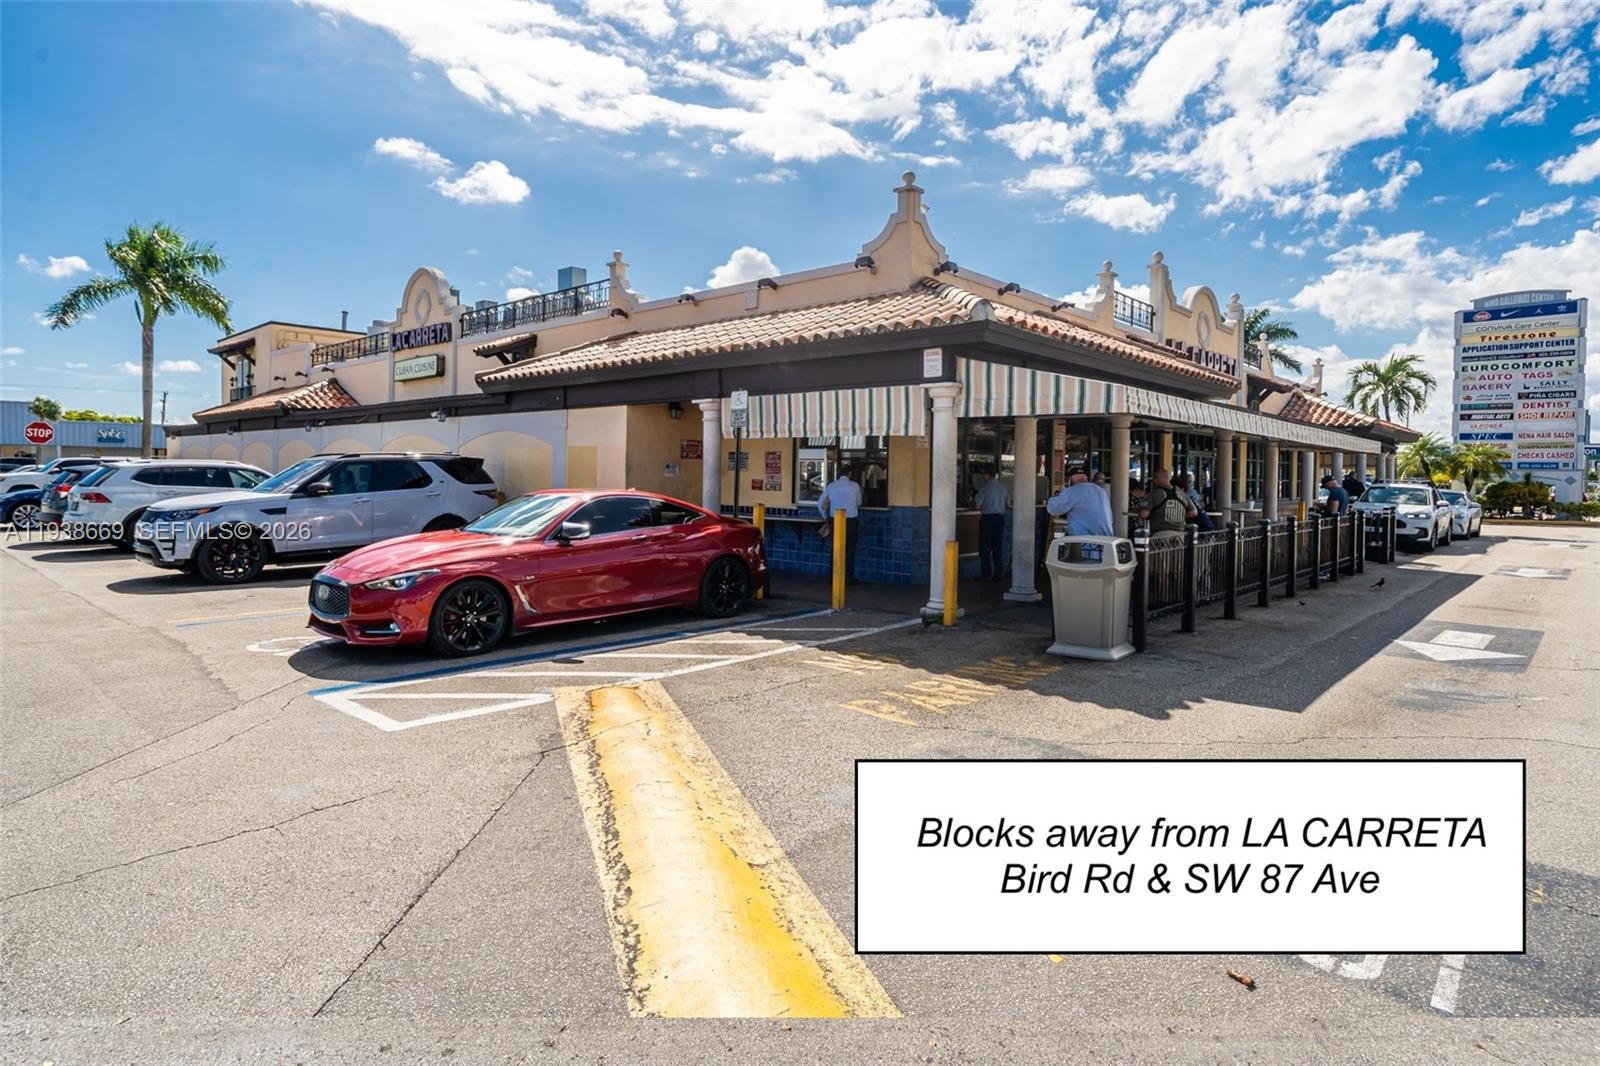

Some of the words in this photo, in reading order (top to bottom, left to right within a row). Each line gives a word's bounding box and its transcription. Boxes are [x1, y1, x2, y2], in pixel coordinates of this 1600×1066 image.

[1531, 292, 1554, 302] CENTER
[1534, 320, 1560, 328] Center
[402, 322, 451, 350] CARRETA
[1462, 341, 1509, 353] APPLICATION
[1509, 340, 1544, 351] SUPPORT
[1545, 338, 1575, 348] CENTER
[396, 364, 413, 377] CUBAN
[414, 360, 436, 374] CUISINE
[1461, 360, 1575, 373] EUROCOMFORT
[1478, 373, 1513, 381] AUTO
[1522, 371, 1554, 379] TAGS
[1462, 383, 1512, 391] BAKERY
[1547, 390, 1575, 398] CIGARS
[1522, 401, 1571, 409] DENTIST
[1542, 411, 1574, 419] REPAIR
[27, 427, 52, 438] STOP
